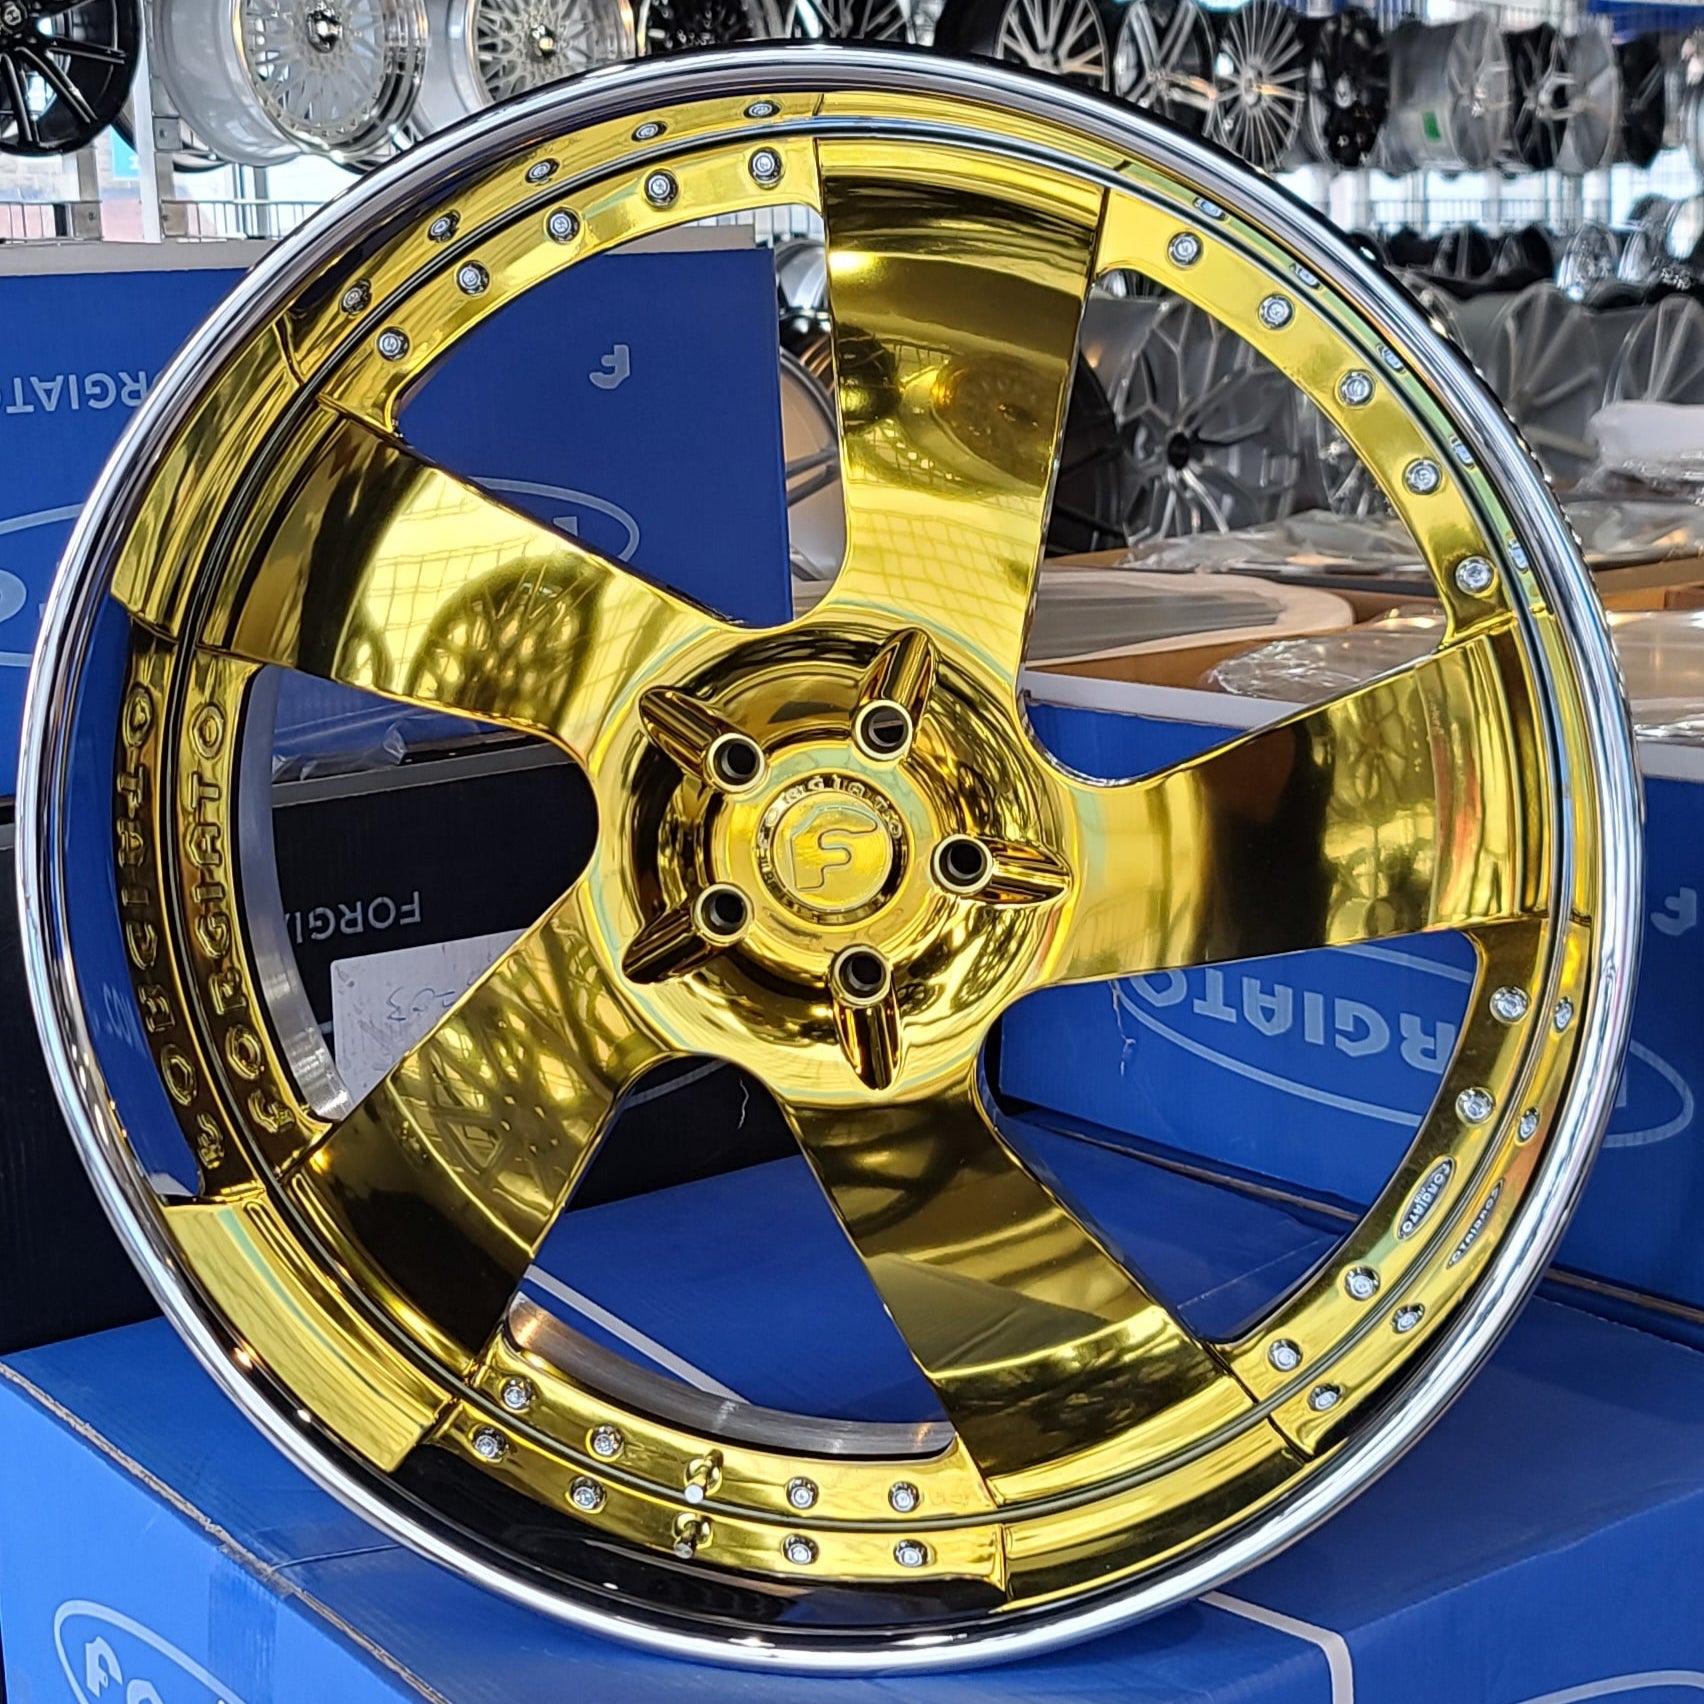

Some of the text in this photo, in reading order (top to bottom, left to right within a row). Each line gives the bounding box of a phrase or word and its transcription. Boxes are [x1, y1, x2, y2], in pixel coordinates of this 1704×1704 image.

[4, 370, 158, 414] RGIAT
[184, 701, 296, 1134] FORGIATO
[285, 890, 421, 944] FORGI
[1129, 966, 1456, 1075] RGIATO
